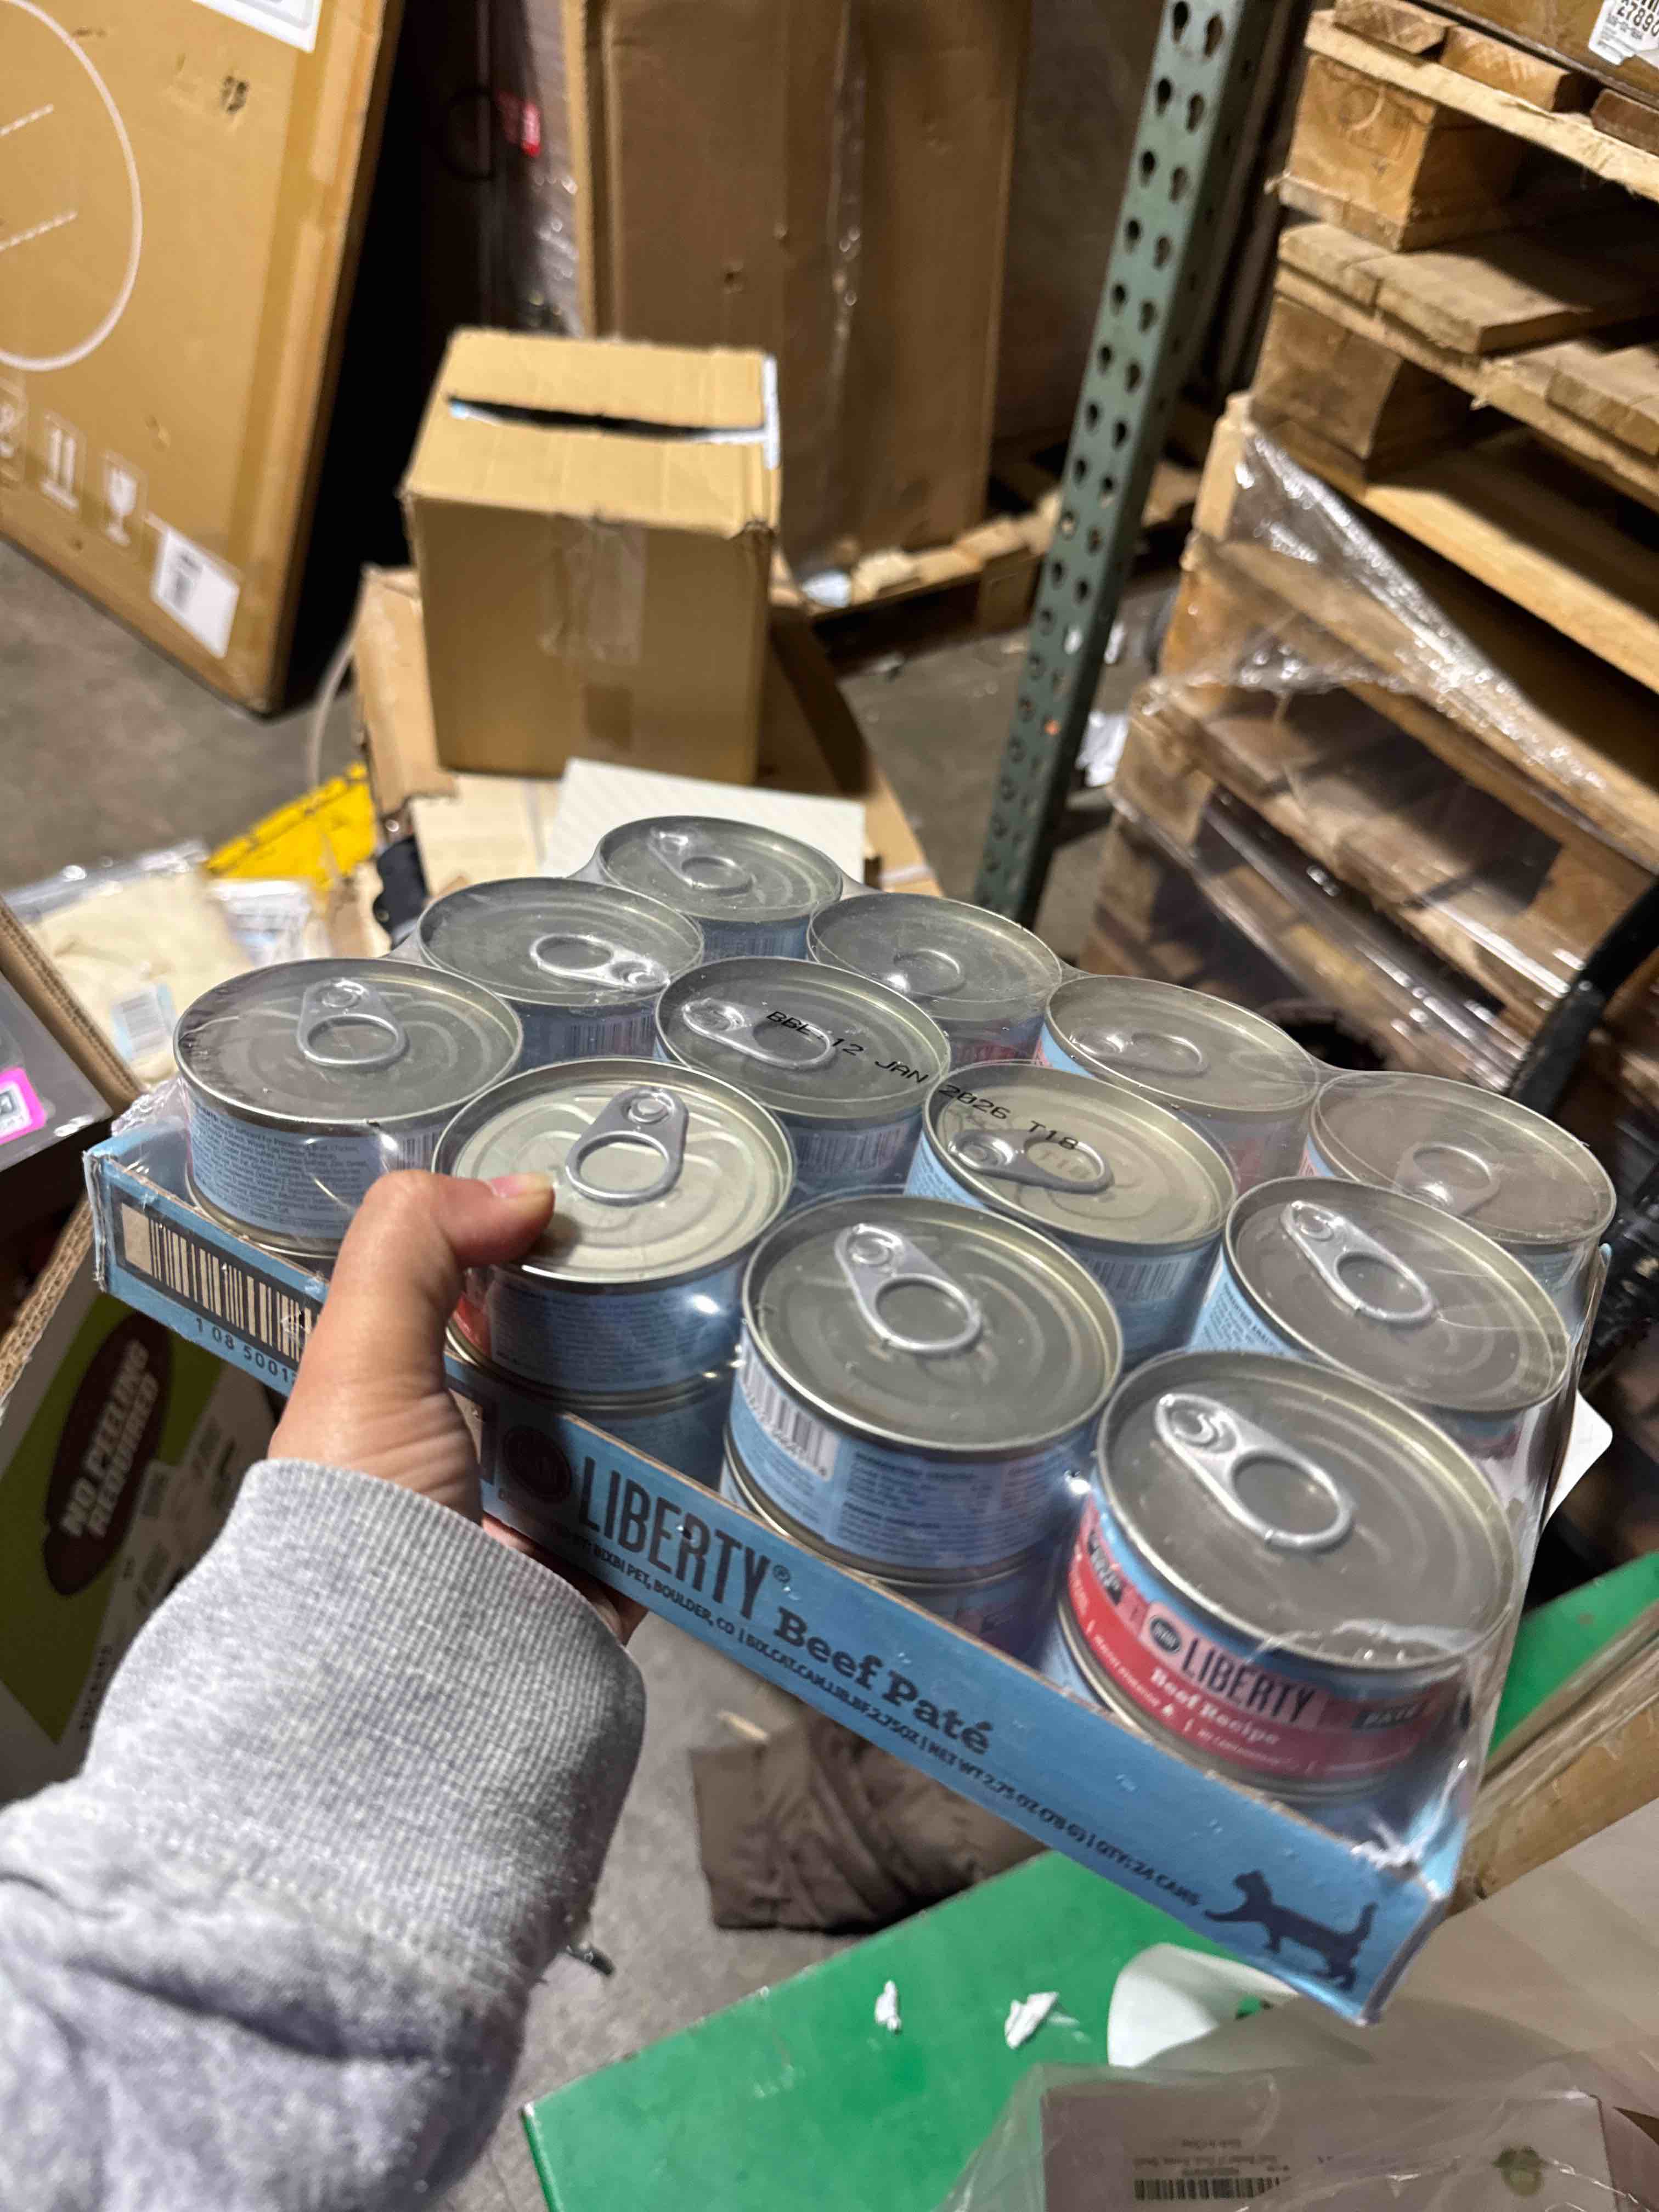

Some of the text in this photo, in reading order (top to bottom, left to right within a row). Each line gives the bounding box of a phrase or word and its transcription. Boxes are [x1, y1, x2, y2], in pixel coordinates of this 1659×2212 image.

[832, 1038, 864, 1056] 12
[874, 1060, 929, 1084] JAN
[939, 1084, 1011, 1120] 2026
[196, 1317, 204, 1333] 1
[212, 1326, 235, 1350] 08
[61, 1339, 149, 1537] NO PEELING
[87, 1373, 159, 1537] REQUIRED
[626, 1560, 652, 1590] PET,
[654, 1579, 714, 1626] BOULDER,
[716, 1617, 736, 1635] CO
[958, 1758, 984, 1779] WT
[773, 1605, 883, 1690] Beef
[882, 1669, 993, 1755] Paté
[1150, 1667, 1201, 1710] Beef
[1199, 1702, 1280, 1744] Recipe
[1181, 1637, 1316, 1723] LIBERTY
